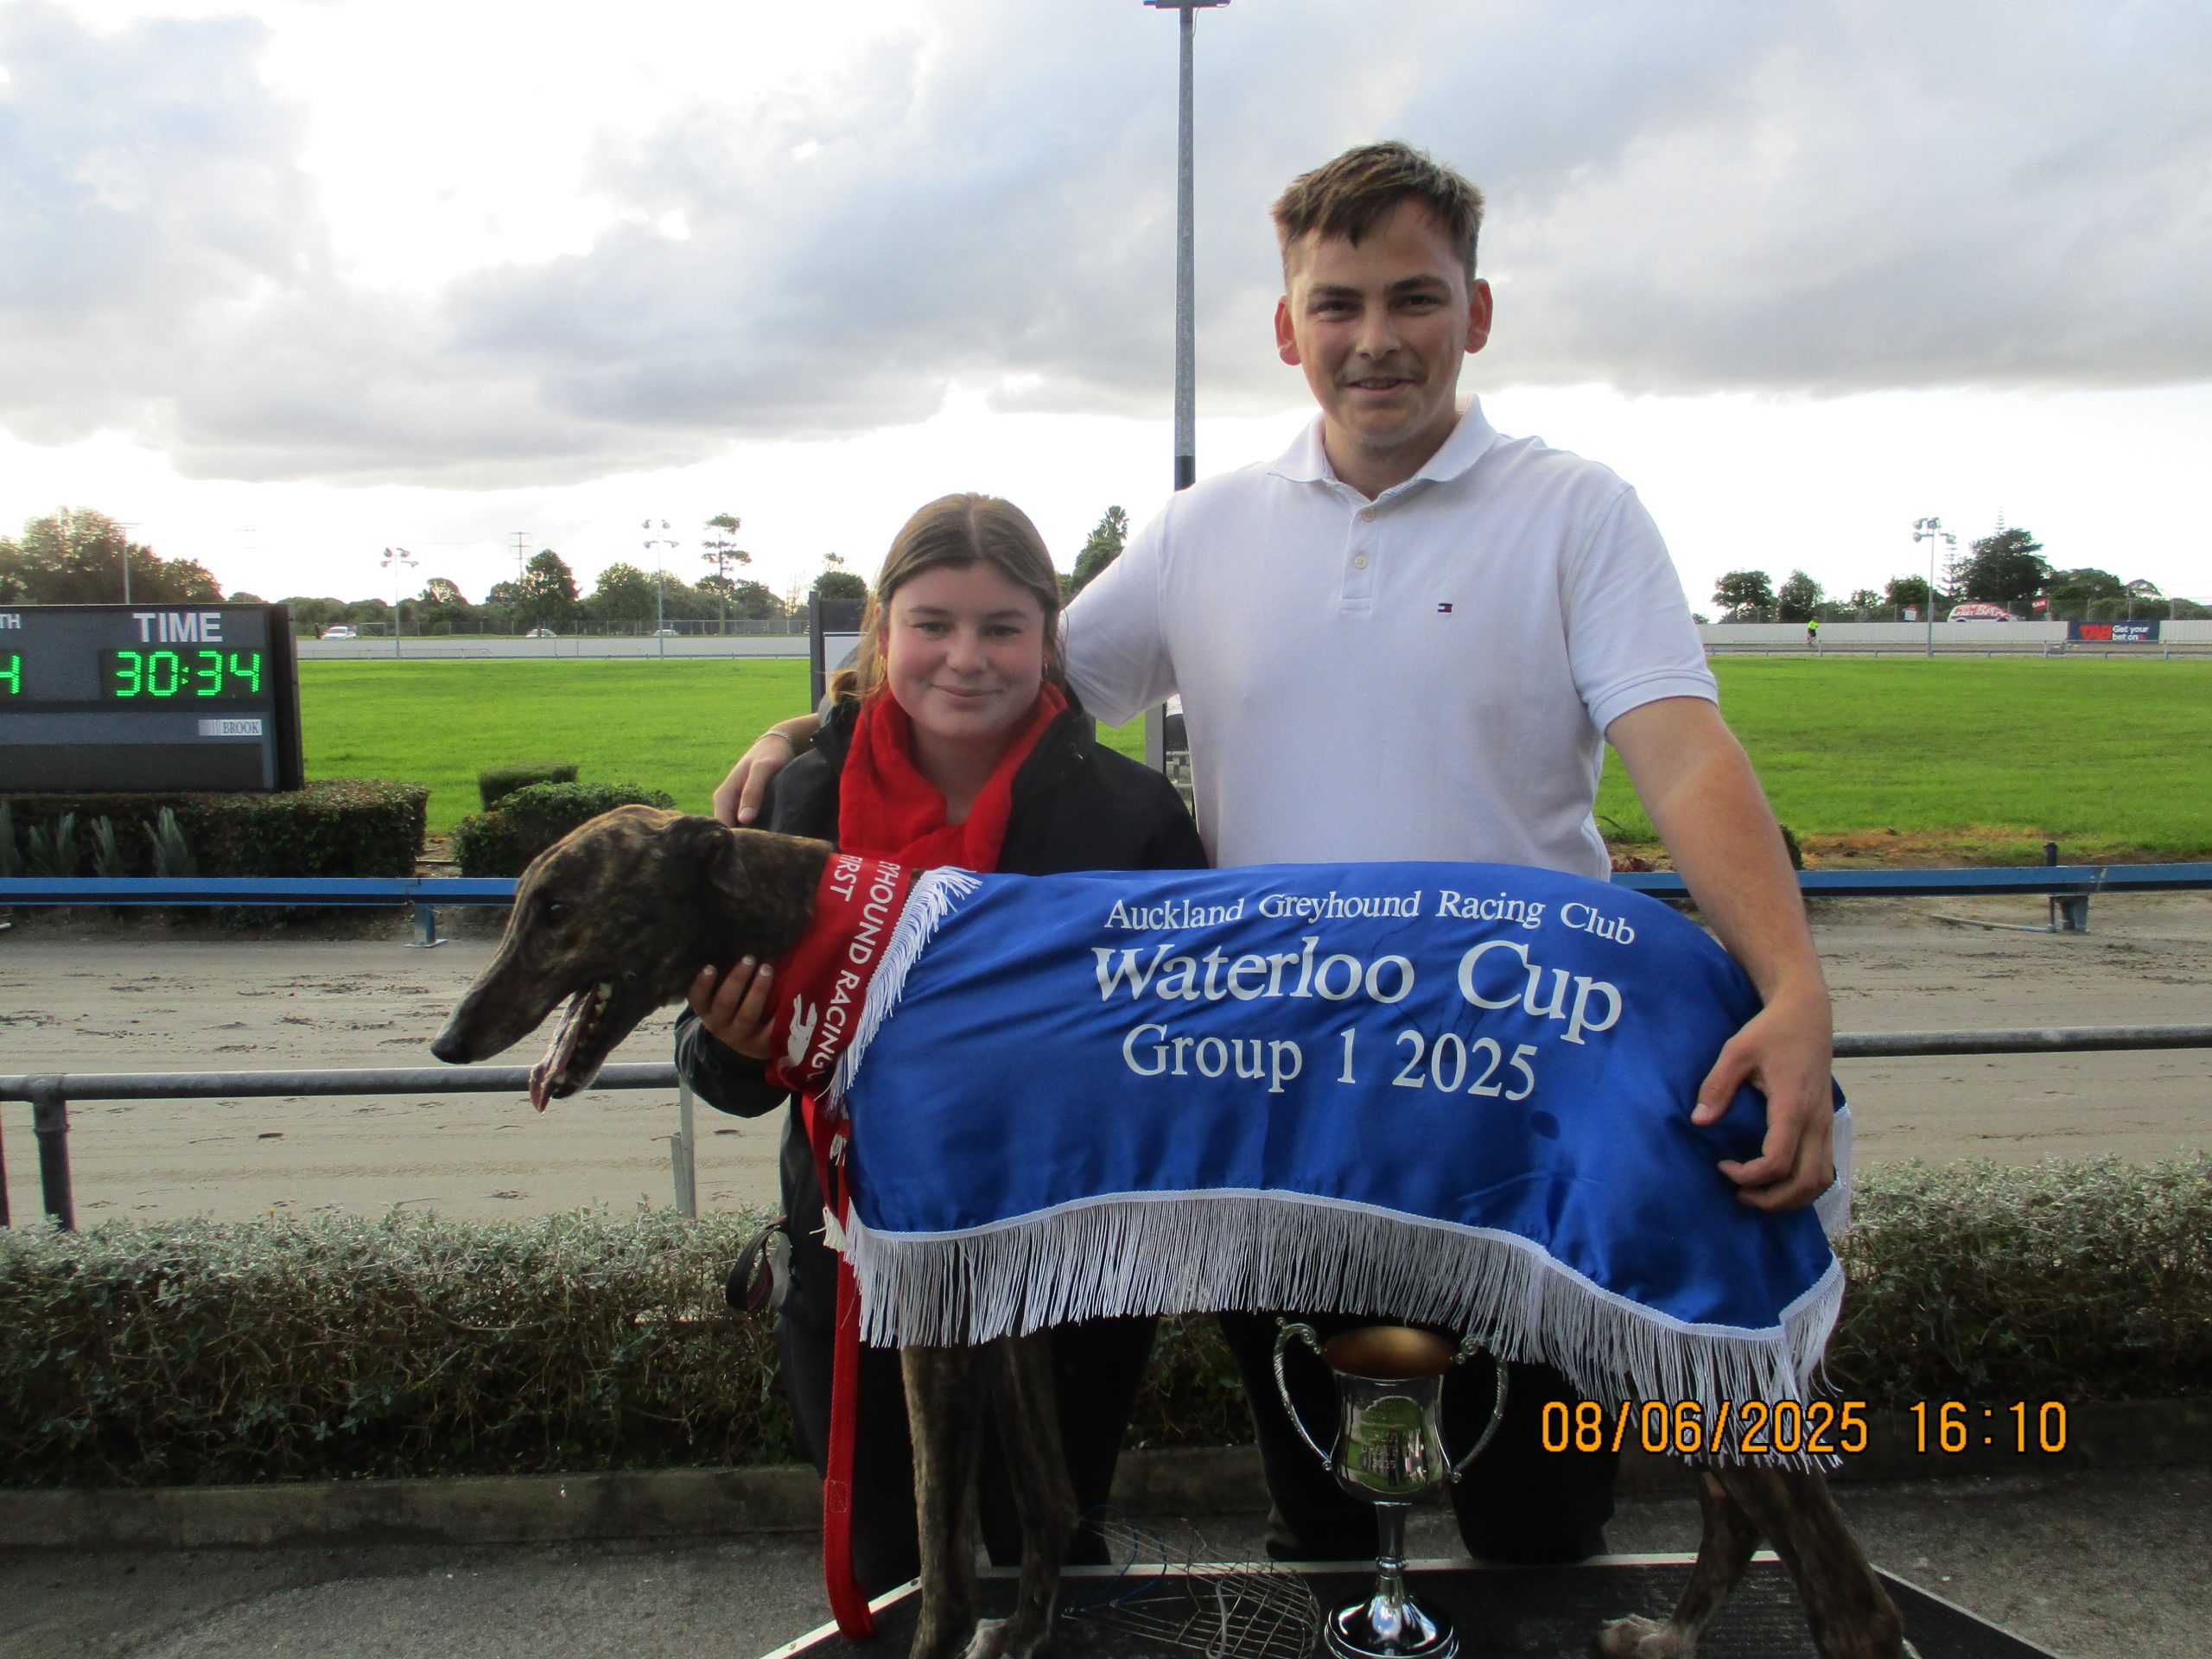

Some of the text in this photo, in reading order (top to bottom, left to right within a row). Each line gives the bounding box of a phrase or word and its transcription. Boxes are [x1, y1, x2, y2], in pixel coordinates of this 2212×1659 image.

[132, 613, 223, 642] TIME
[2129, 626, 2150, 635] your
[116, 651, 261, 696] 30:34
[222, 721, 259, 734] BROOK
[1104, 890, 1636, 945] Auckland Greyhound Racing Club
[1092, 936, 1623, 1046] Waterloo Cup
[810, 969, 861, 1070] RACING
[1122, 1023, 1538, 1102] Group 1 2025
